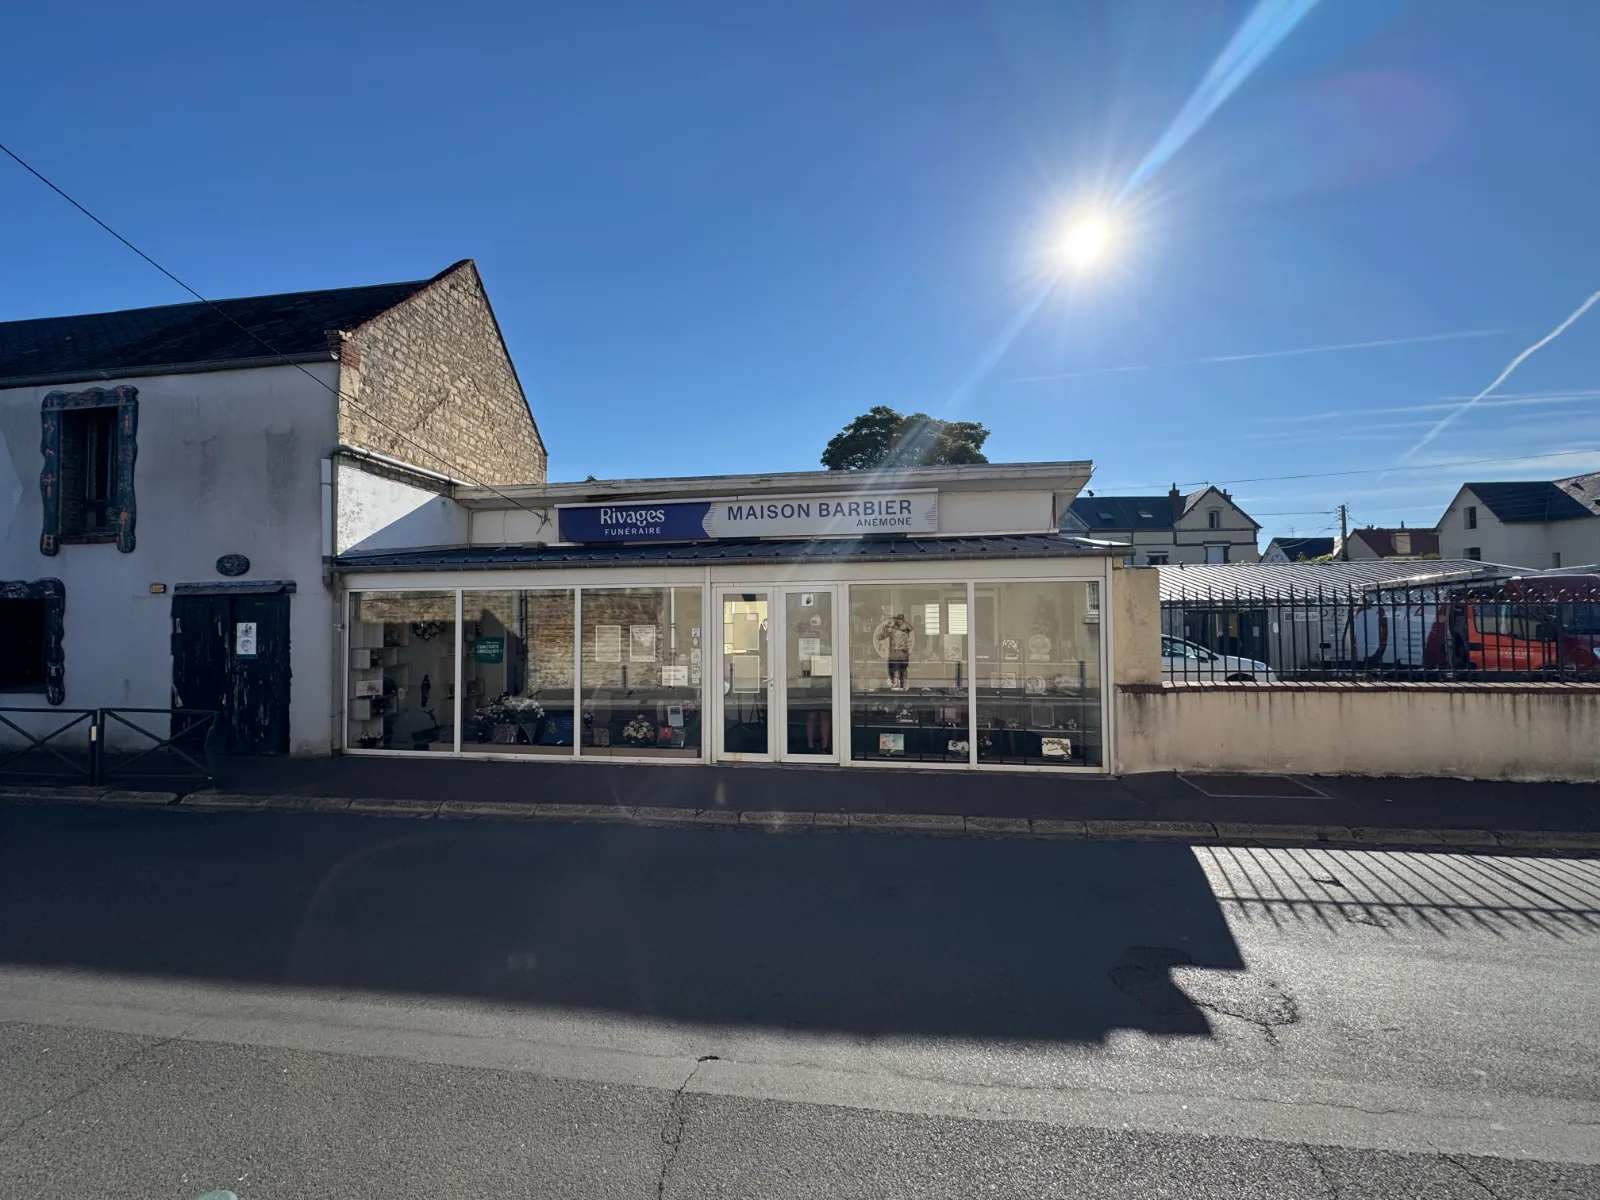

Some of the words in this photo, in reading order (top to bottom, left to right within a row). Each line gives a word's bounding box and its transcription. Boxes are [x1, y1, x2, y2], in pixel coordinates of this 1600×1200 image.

[600, 507, 665, 527] Rivages
[727, 503, 810, 521] MAISON
[818, 499, 912, 517] BARBIER
[856, 517, 912, 527] ANÉMONE
[604, 527, 662, 536] FUNÉRAIRE
